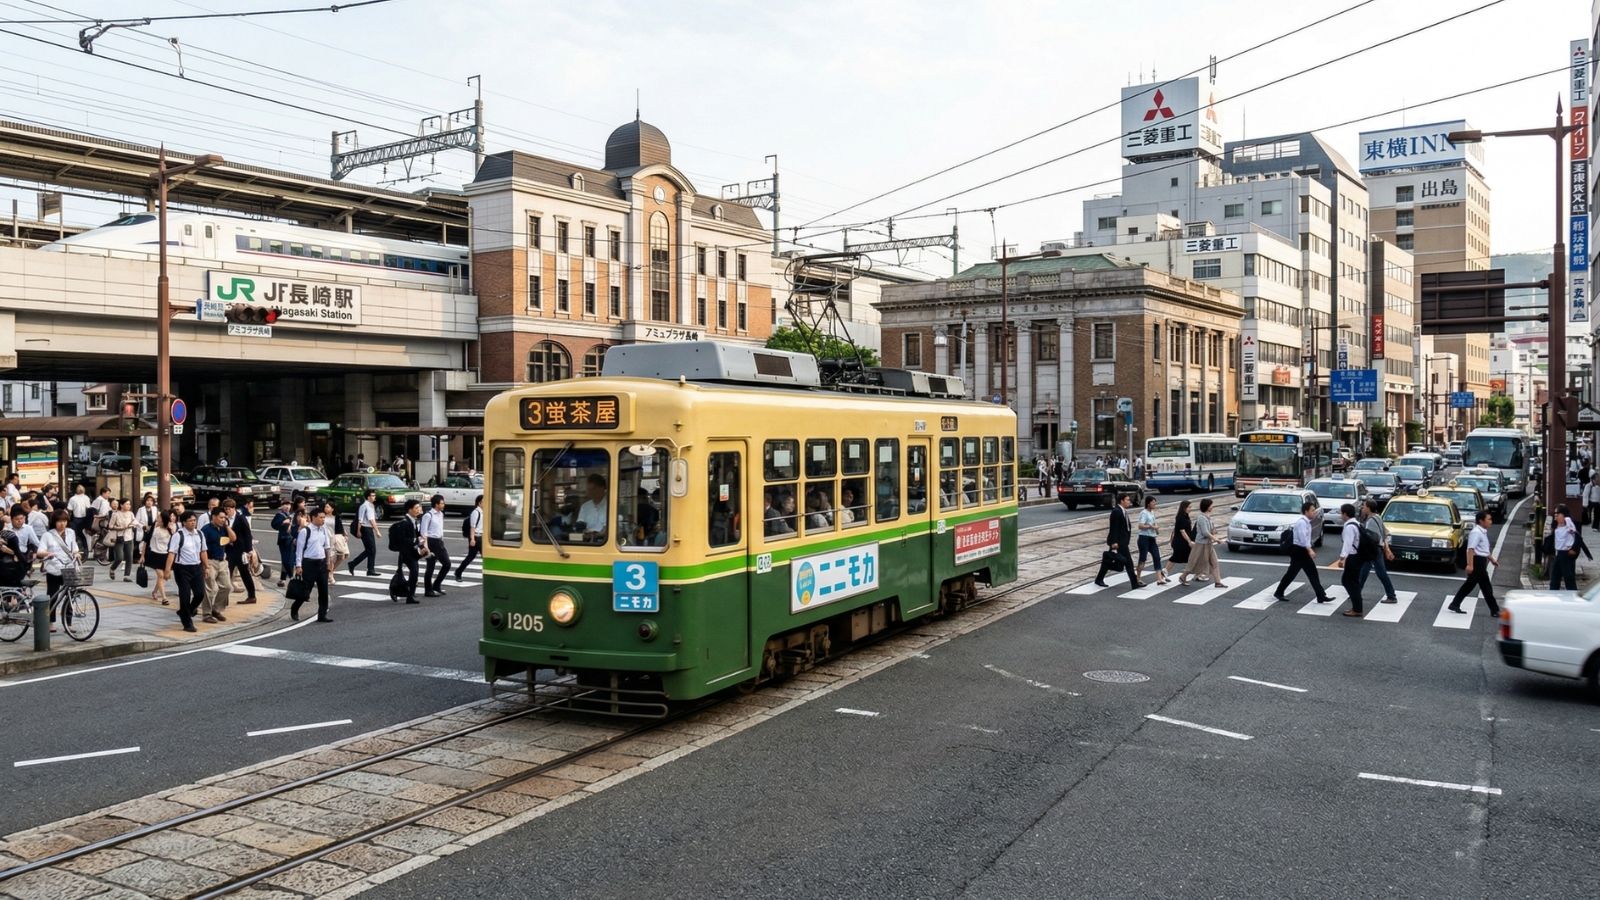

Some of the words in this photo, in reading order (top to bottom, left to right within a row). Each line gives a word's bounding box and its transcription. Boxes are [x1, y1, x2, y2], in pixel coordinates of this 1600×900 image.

[1127, 123, 1193, 148] 三菱重工
[1364, 132, 1458, 161] 東横INN
[1421, 178, 1458, 198] 出島
[1186, 237, 1238, 252] 三菱重工
[216, 277, 256, 302] JR
[321, 308, 353, 320] Station
[1243, 352, 1255, 396] 三菱重工
[625, 563, 647, 591] 3
[620, 596, 653, 609] ニモカ
[507, 612, 544, 633] 1205
